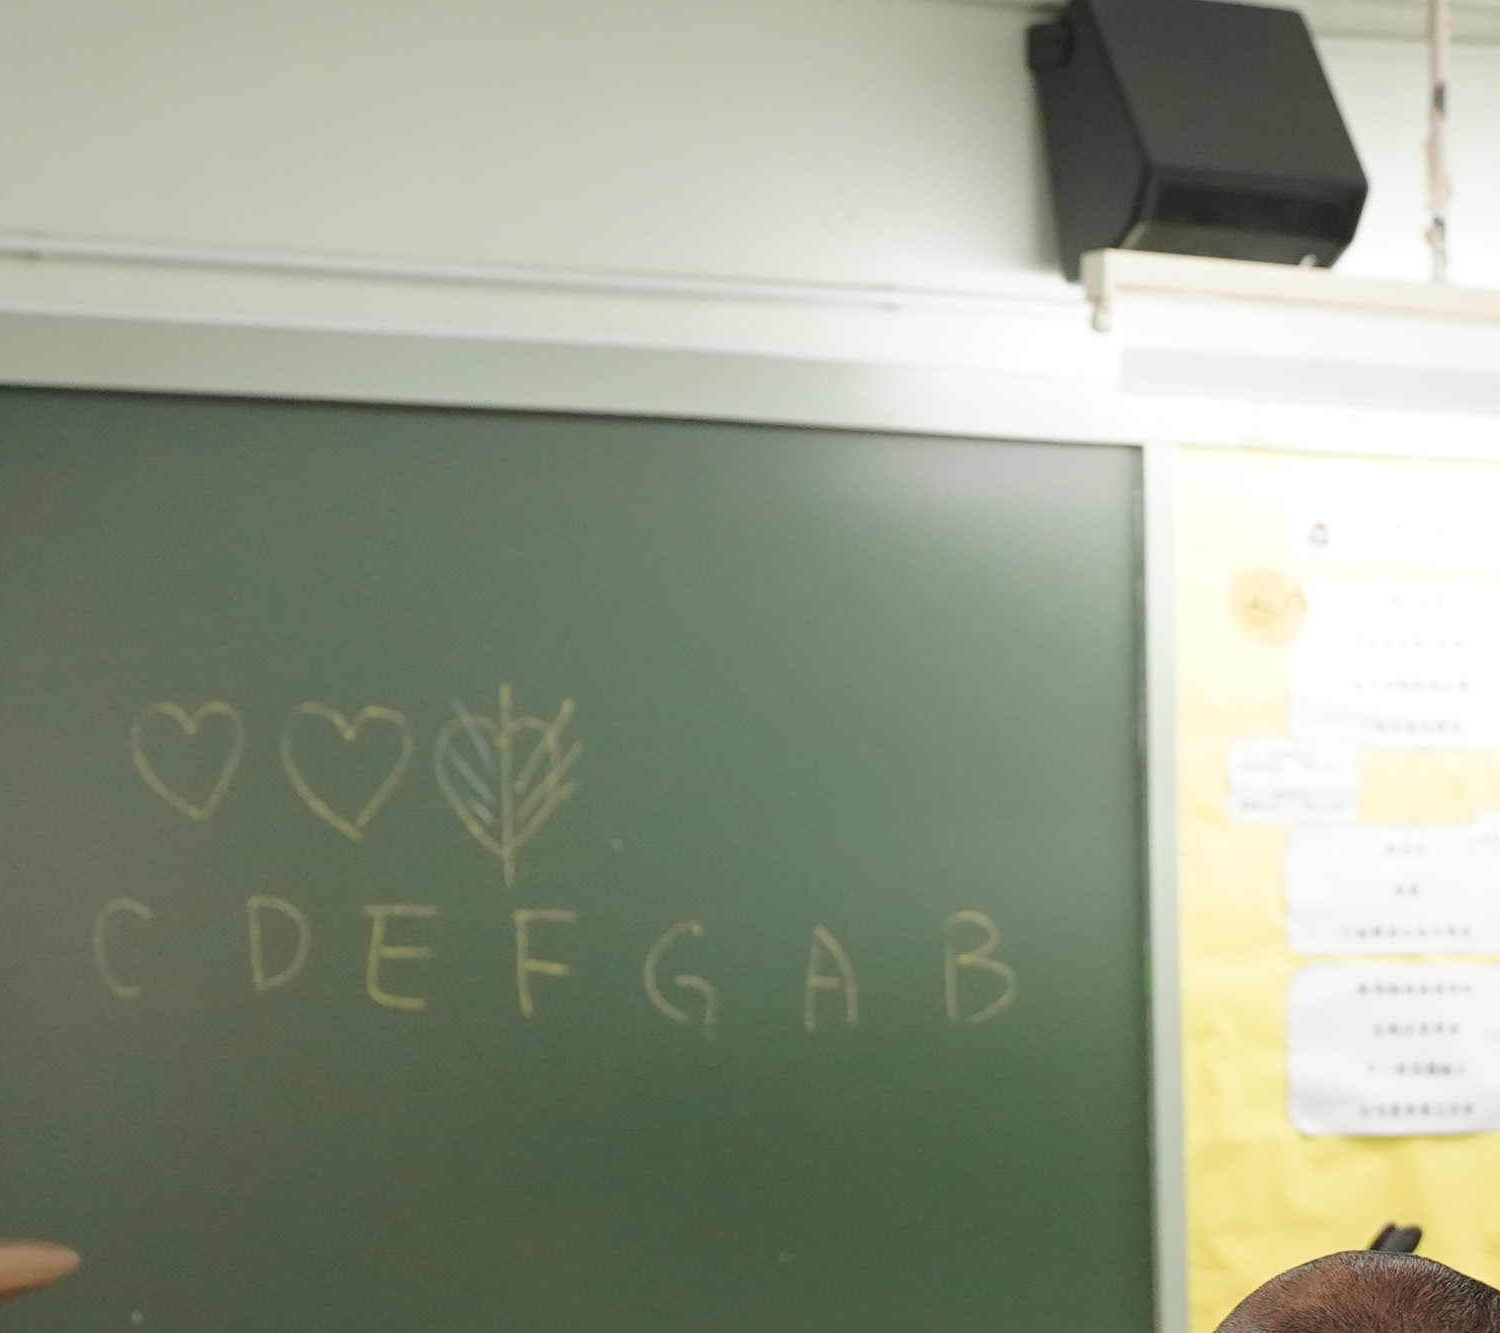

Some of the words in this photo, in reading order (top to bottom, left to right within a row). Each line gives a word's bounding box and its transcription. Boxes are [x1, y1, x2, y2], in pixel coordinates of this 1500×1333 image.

[93, 896, 152, 997] C
[245, 894, 311, 991] D
[363, 902, 438, 1011] E
[512, 907, 578, 1017] F
[643, 920, 717, 1039] G
[803, 924, 858, 1033] A
[943, 910, 1019, 1025] B
